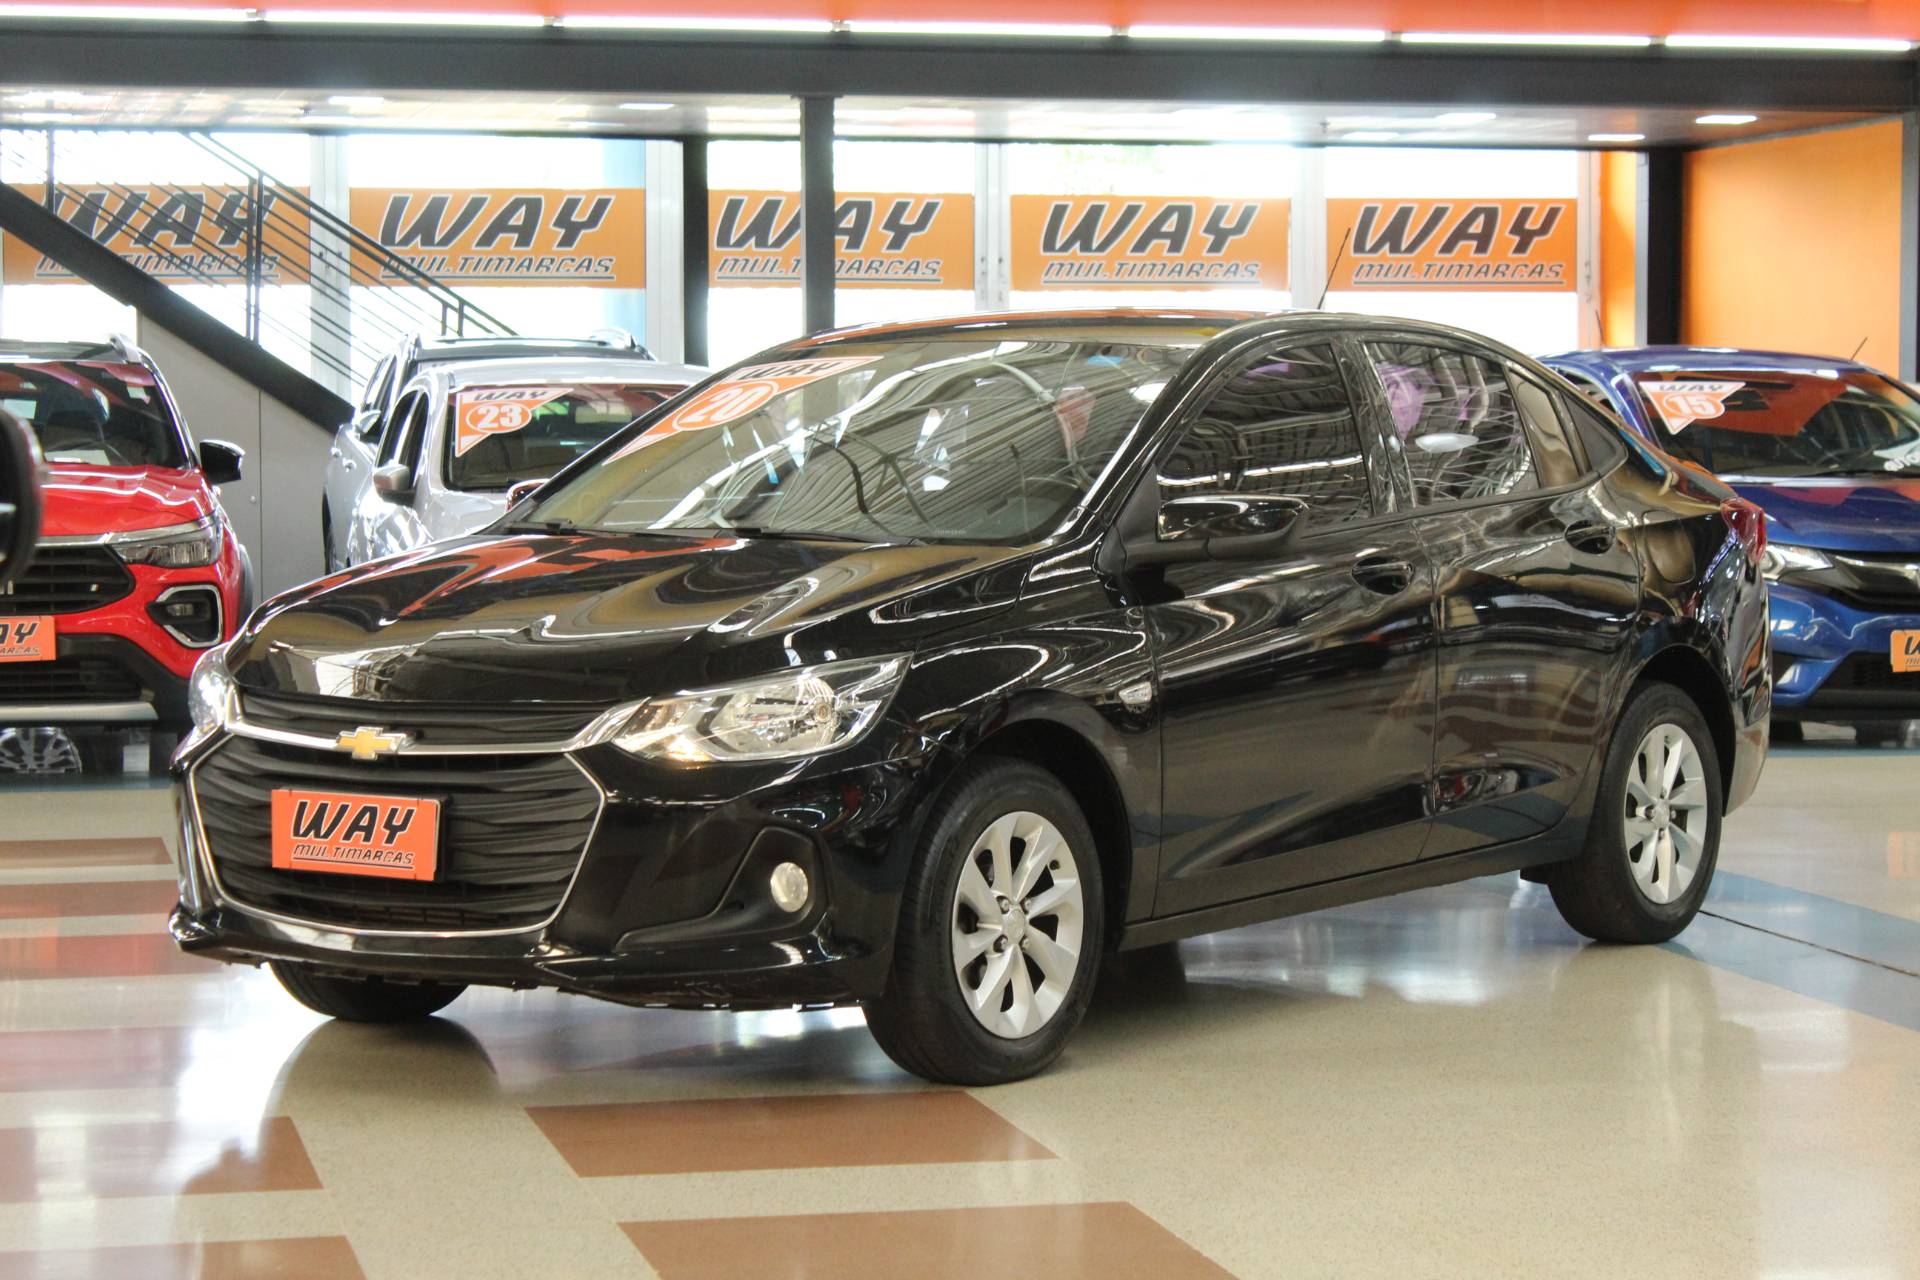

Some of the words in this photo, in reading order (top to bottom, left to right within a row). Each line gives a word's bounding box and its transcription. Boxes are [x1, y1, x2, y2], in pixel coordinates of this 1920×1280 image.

[380, 195, 614, 248] WAY
[716, 197, 942, 251] WAY
[1041, 203, 1258, 254] WAY
[1352, 205, 1563, 255] WAY
[383, 256, 614, 273] MULTIMARCAS
[718, 257, 941, 276] MULTARCAS
[1044, 262, 1260, 278] MULTIMARCAS
[1354, 263, 1564, 279] MULTIMARCAS
[739, 361, 842, 380] WAY
[473, 391, 548, 401] WAY
[679, 386, 773, 425] 20
[476, 404, 523, 430] 23
[292, 800, 416, 846] WAY
[292, 844, 415, 864] MULTIMARCAS
